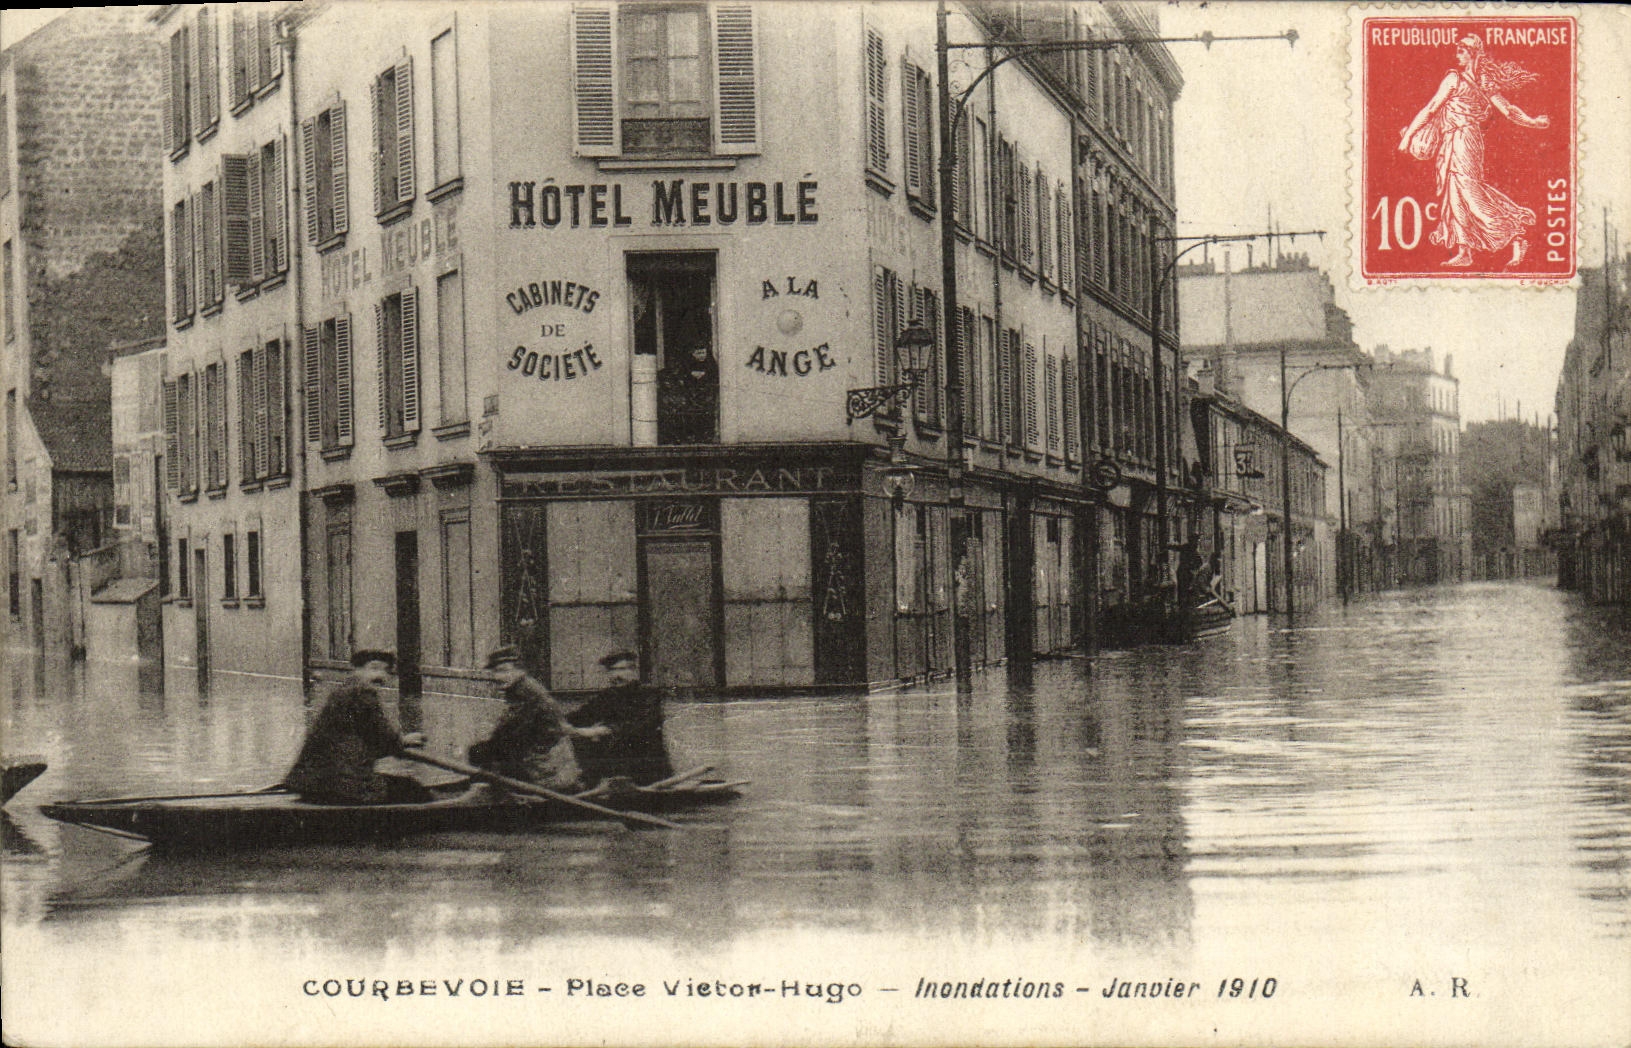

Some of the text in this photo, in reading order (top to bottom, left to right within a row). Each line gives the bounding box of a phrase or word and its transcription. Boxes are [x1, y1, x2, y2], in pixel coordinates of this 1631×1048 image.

[1371, 27, 1568, 48] REPUBLIQUE FRANÇAISE
[508, 173, 819, 230] HÔTEL MEUBLÉ
[1547, 177, 1567, 263] POSTES
[506, 280, 602, 316] CABINETS
[761, 276, 820, 300] A LA
[540, 323, 566, 339] DE
[506, 340, 603, 381] SOCIÉTÉ
[745, 342, 837, 377] ANGE
